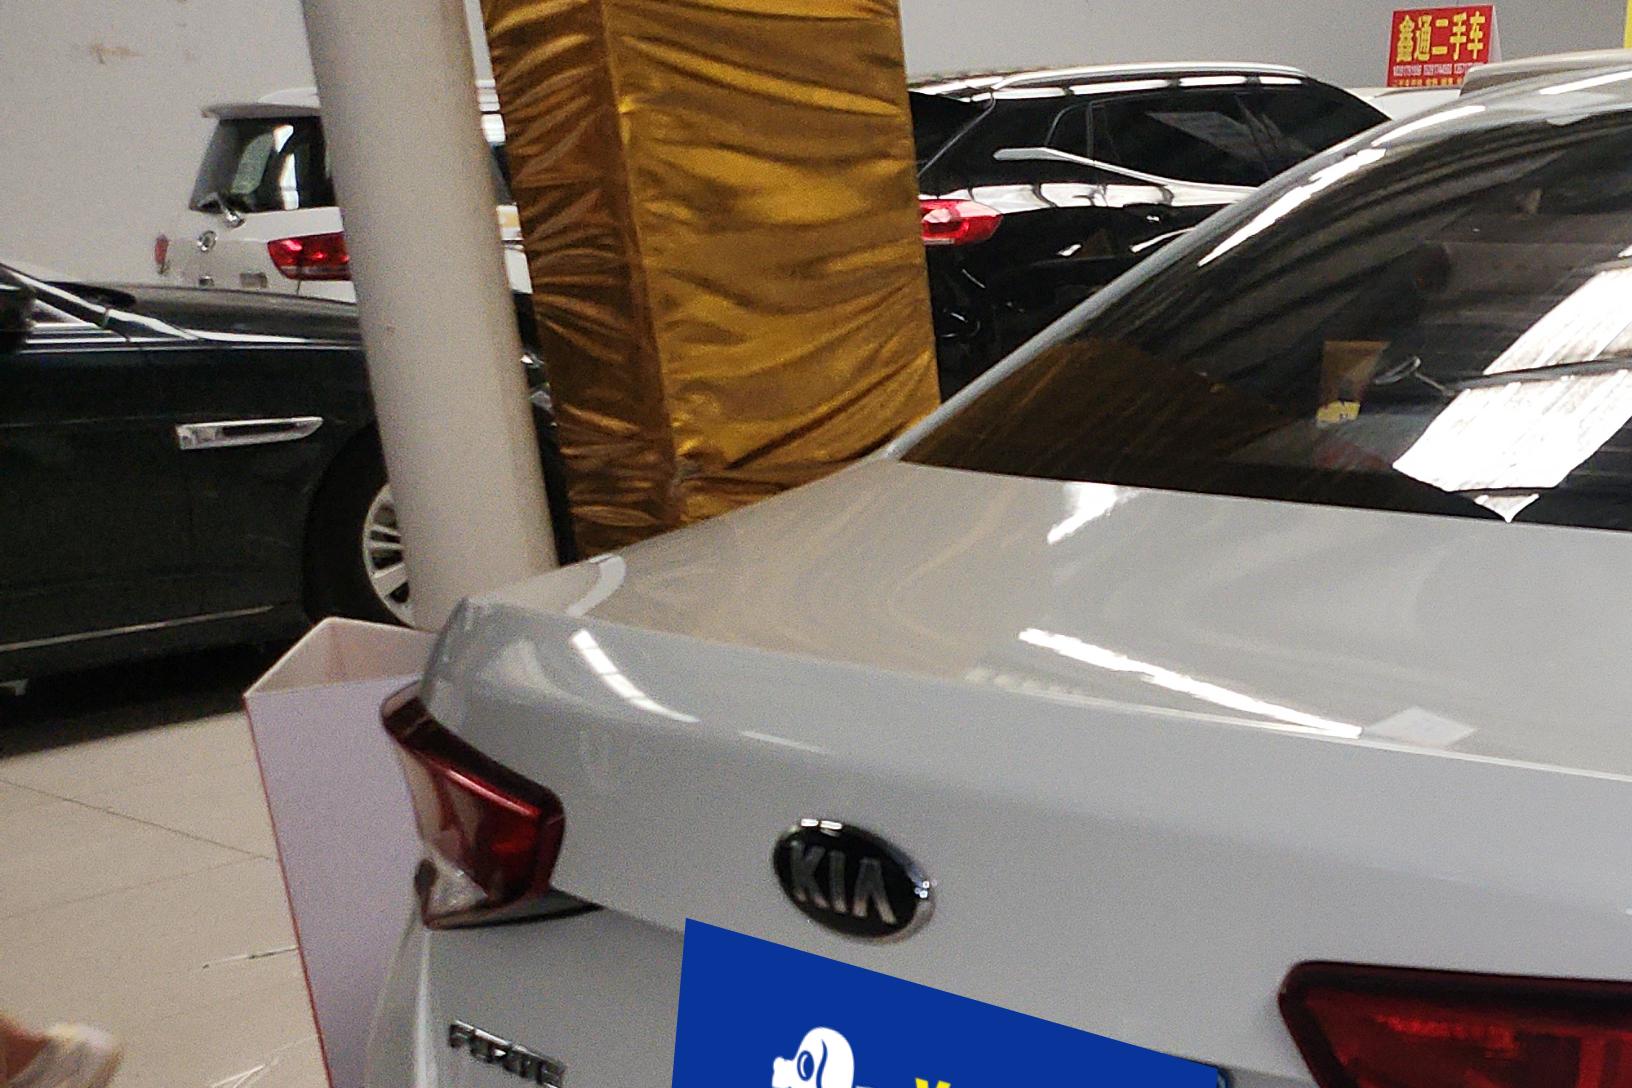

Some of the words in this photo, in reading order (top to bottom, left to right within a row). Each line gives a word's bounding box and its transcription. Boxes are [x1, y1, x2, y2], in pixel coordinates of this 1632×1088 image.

[1396, 10, 1486, 63] 鑫通二手车
[790, 839, 898, 926] KIA
